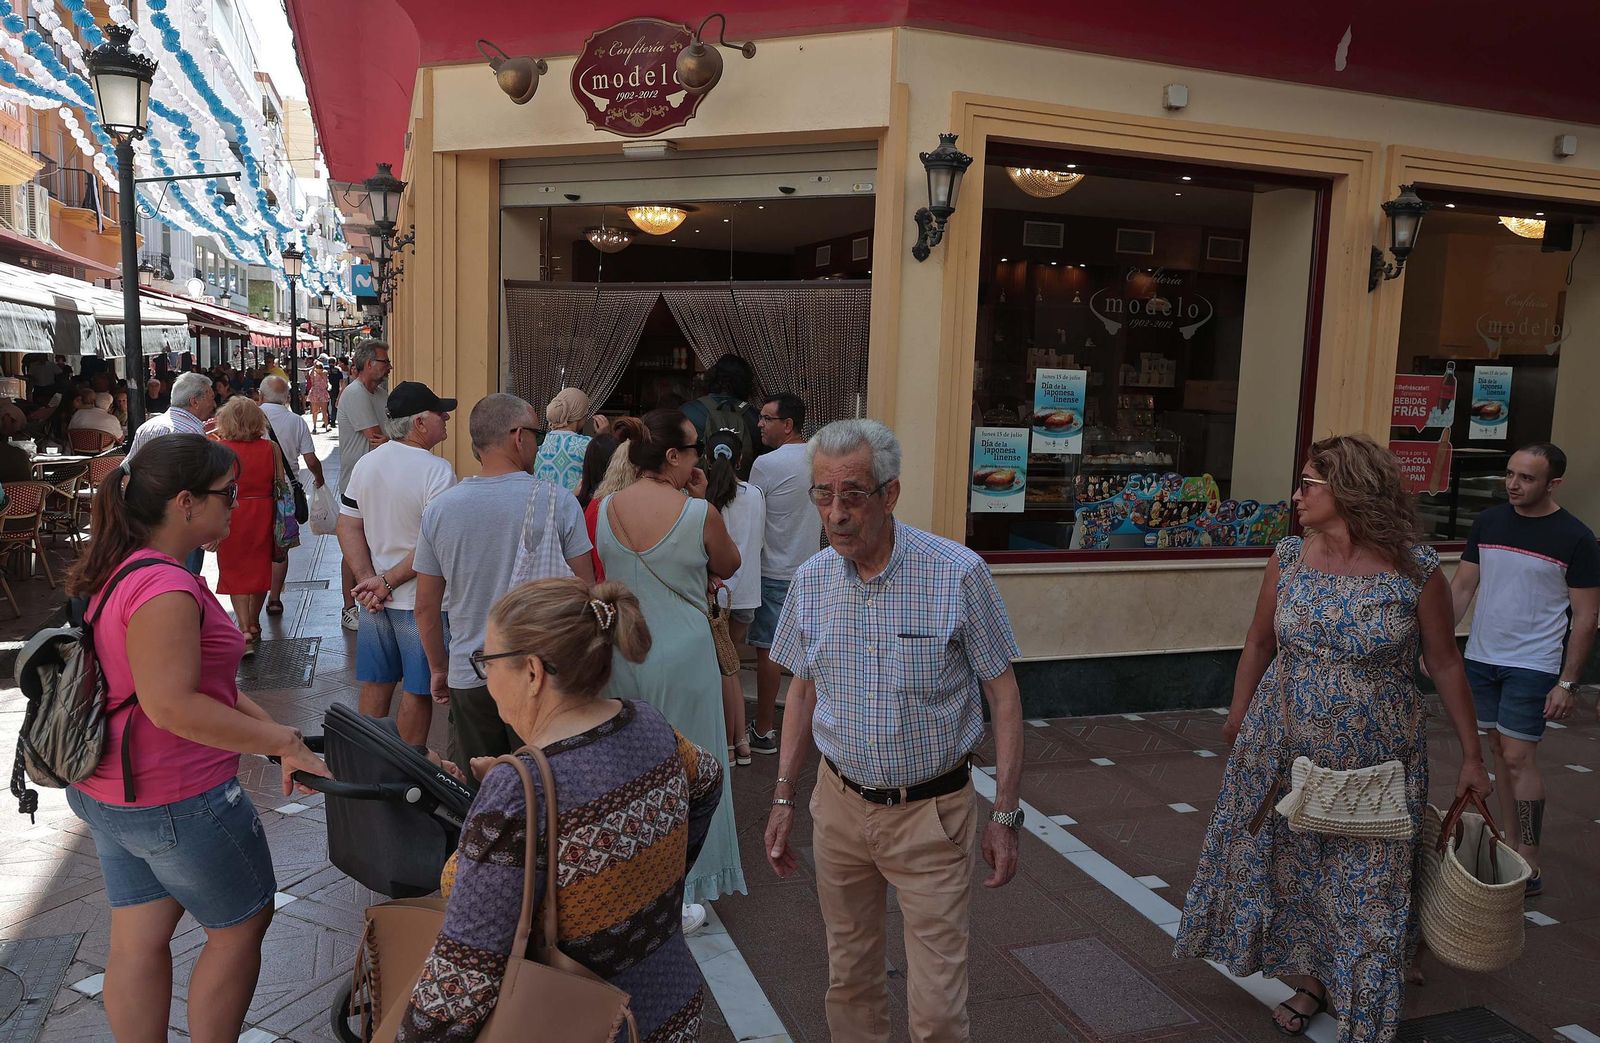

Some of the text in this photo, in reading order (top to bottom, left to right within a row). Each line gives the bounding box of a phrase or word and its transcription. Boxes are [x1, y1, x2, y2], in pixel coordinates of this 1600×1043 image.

[609, 35, 665, 66] Confitería
[615, 90, 659, 103] 1902-2012
[1105, 296, 1200, 318] modelo
[1487, 317, 1561, 337] modelo
[1041, 381, 1053, 389] Día
[1044, 388, 1075, 397] japonesa
[1053, 395, 1079, 403] linense
[1394, 397, 1427, 405] BEBIDAS
[981, 439, 993, 447] Día
[984, 446, 1016, 455] japonesa
[993, 453, 1021, 461] linense
[1397, 456, 1431, 464] CA-COLA
[1401, 465, 1426, 473] BARRA
[1410, 473, 1426, 481] PAN
